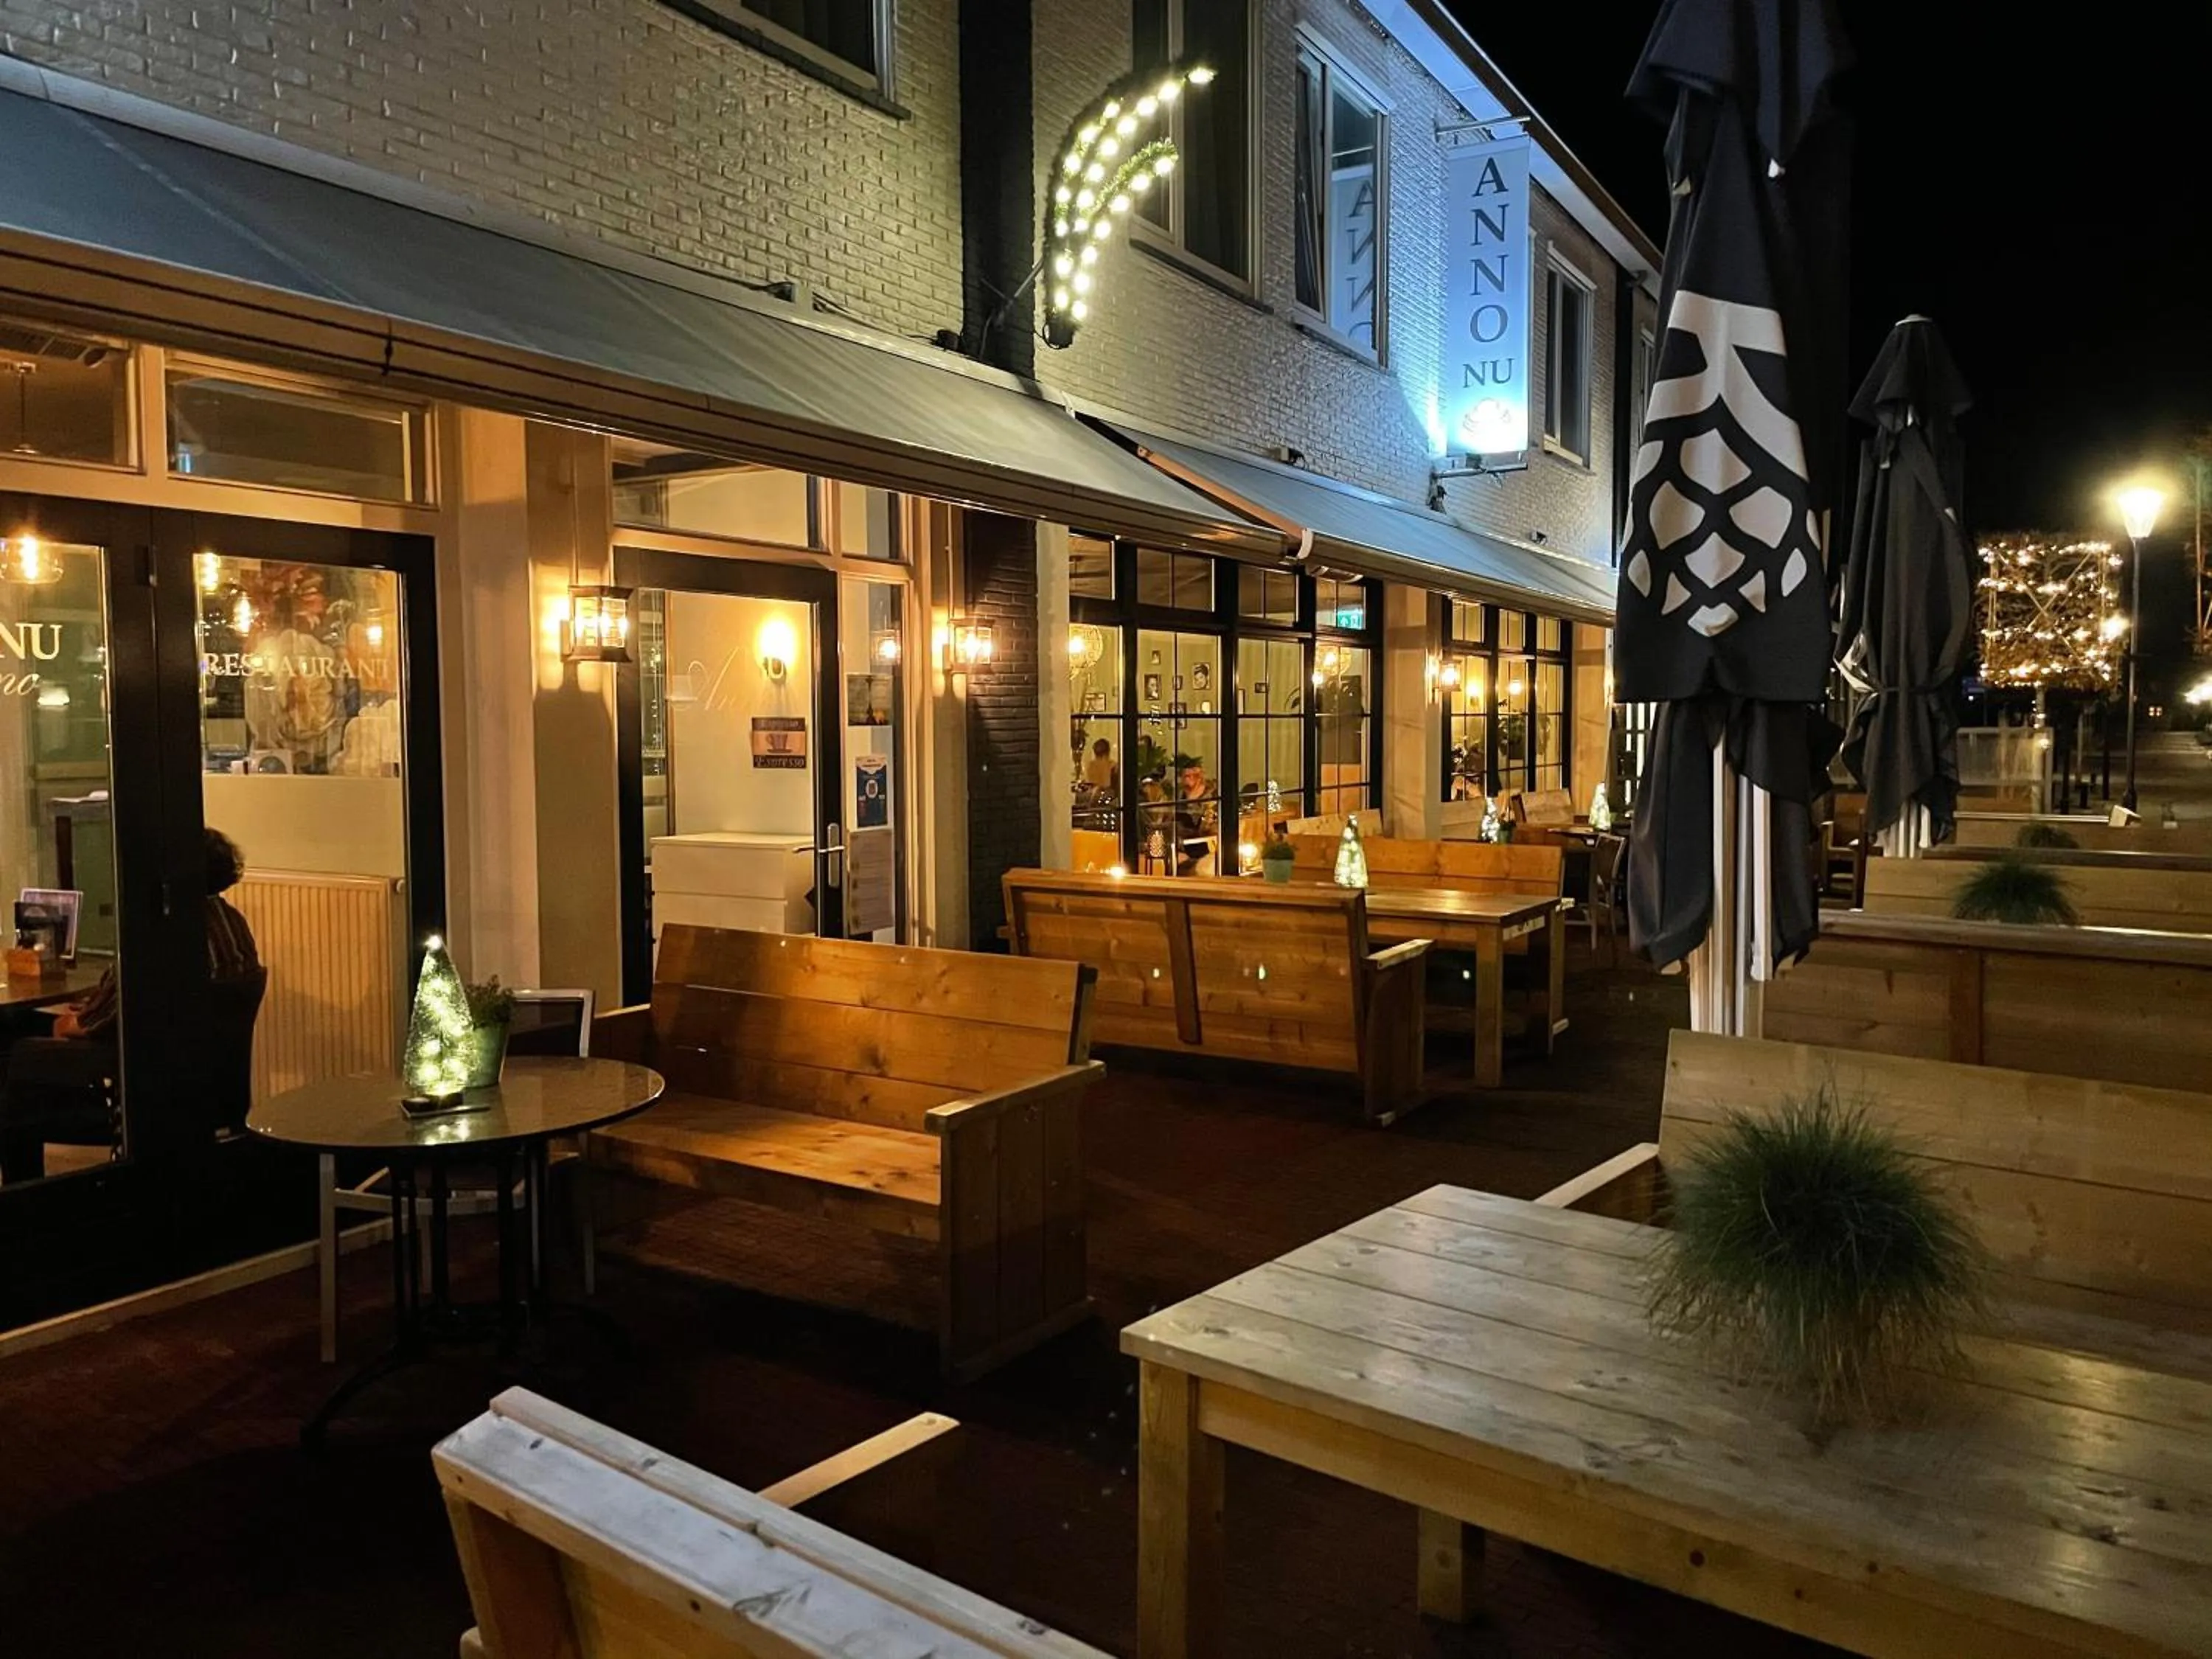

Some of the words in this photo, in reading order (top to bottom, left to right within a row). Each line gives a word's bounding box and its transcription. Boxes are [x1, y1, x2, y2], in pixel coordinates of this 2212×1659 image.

[1469, 156, 1509, 344] ANNO
[1463, 358, 1514, 389] NU
[204, 652, 389, 679] RESTAURANT
